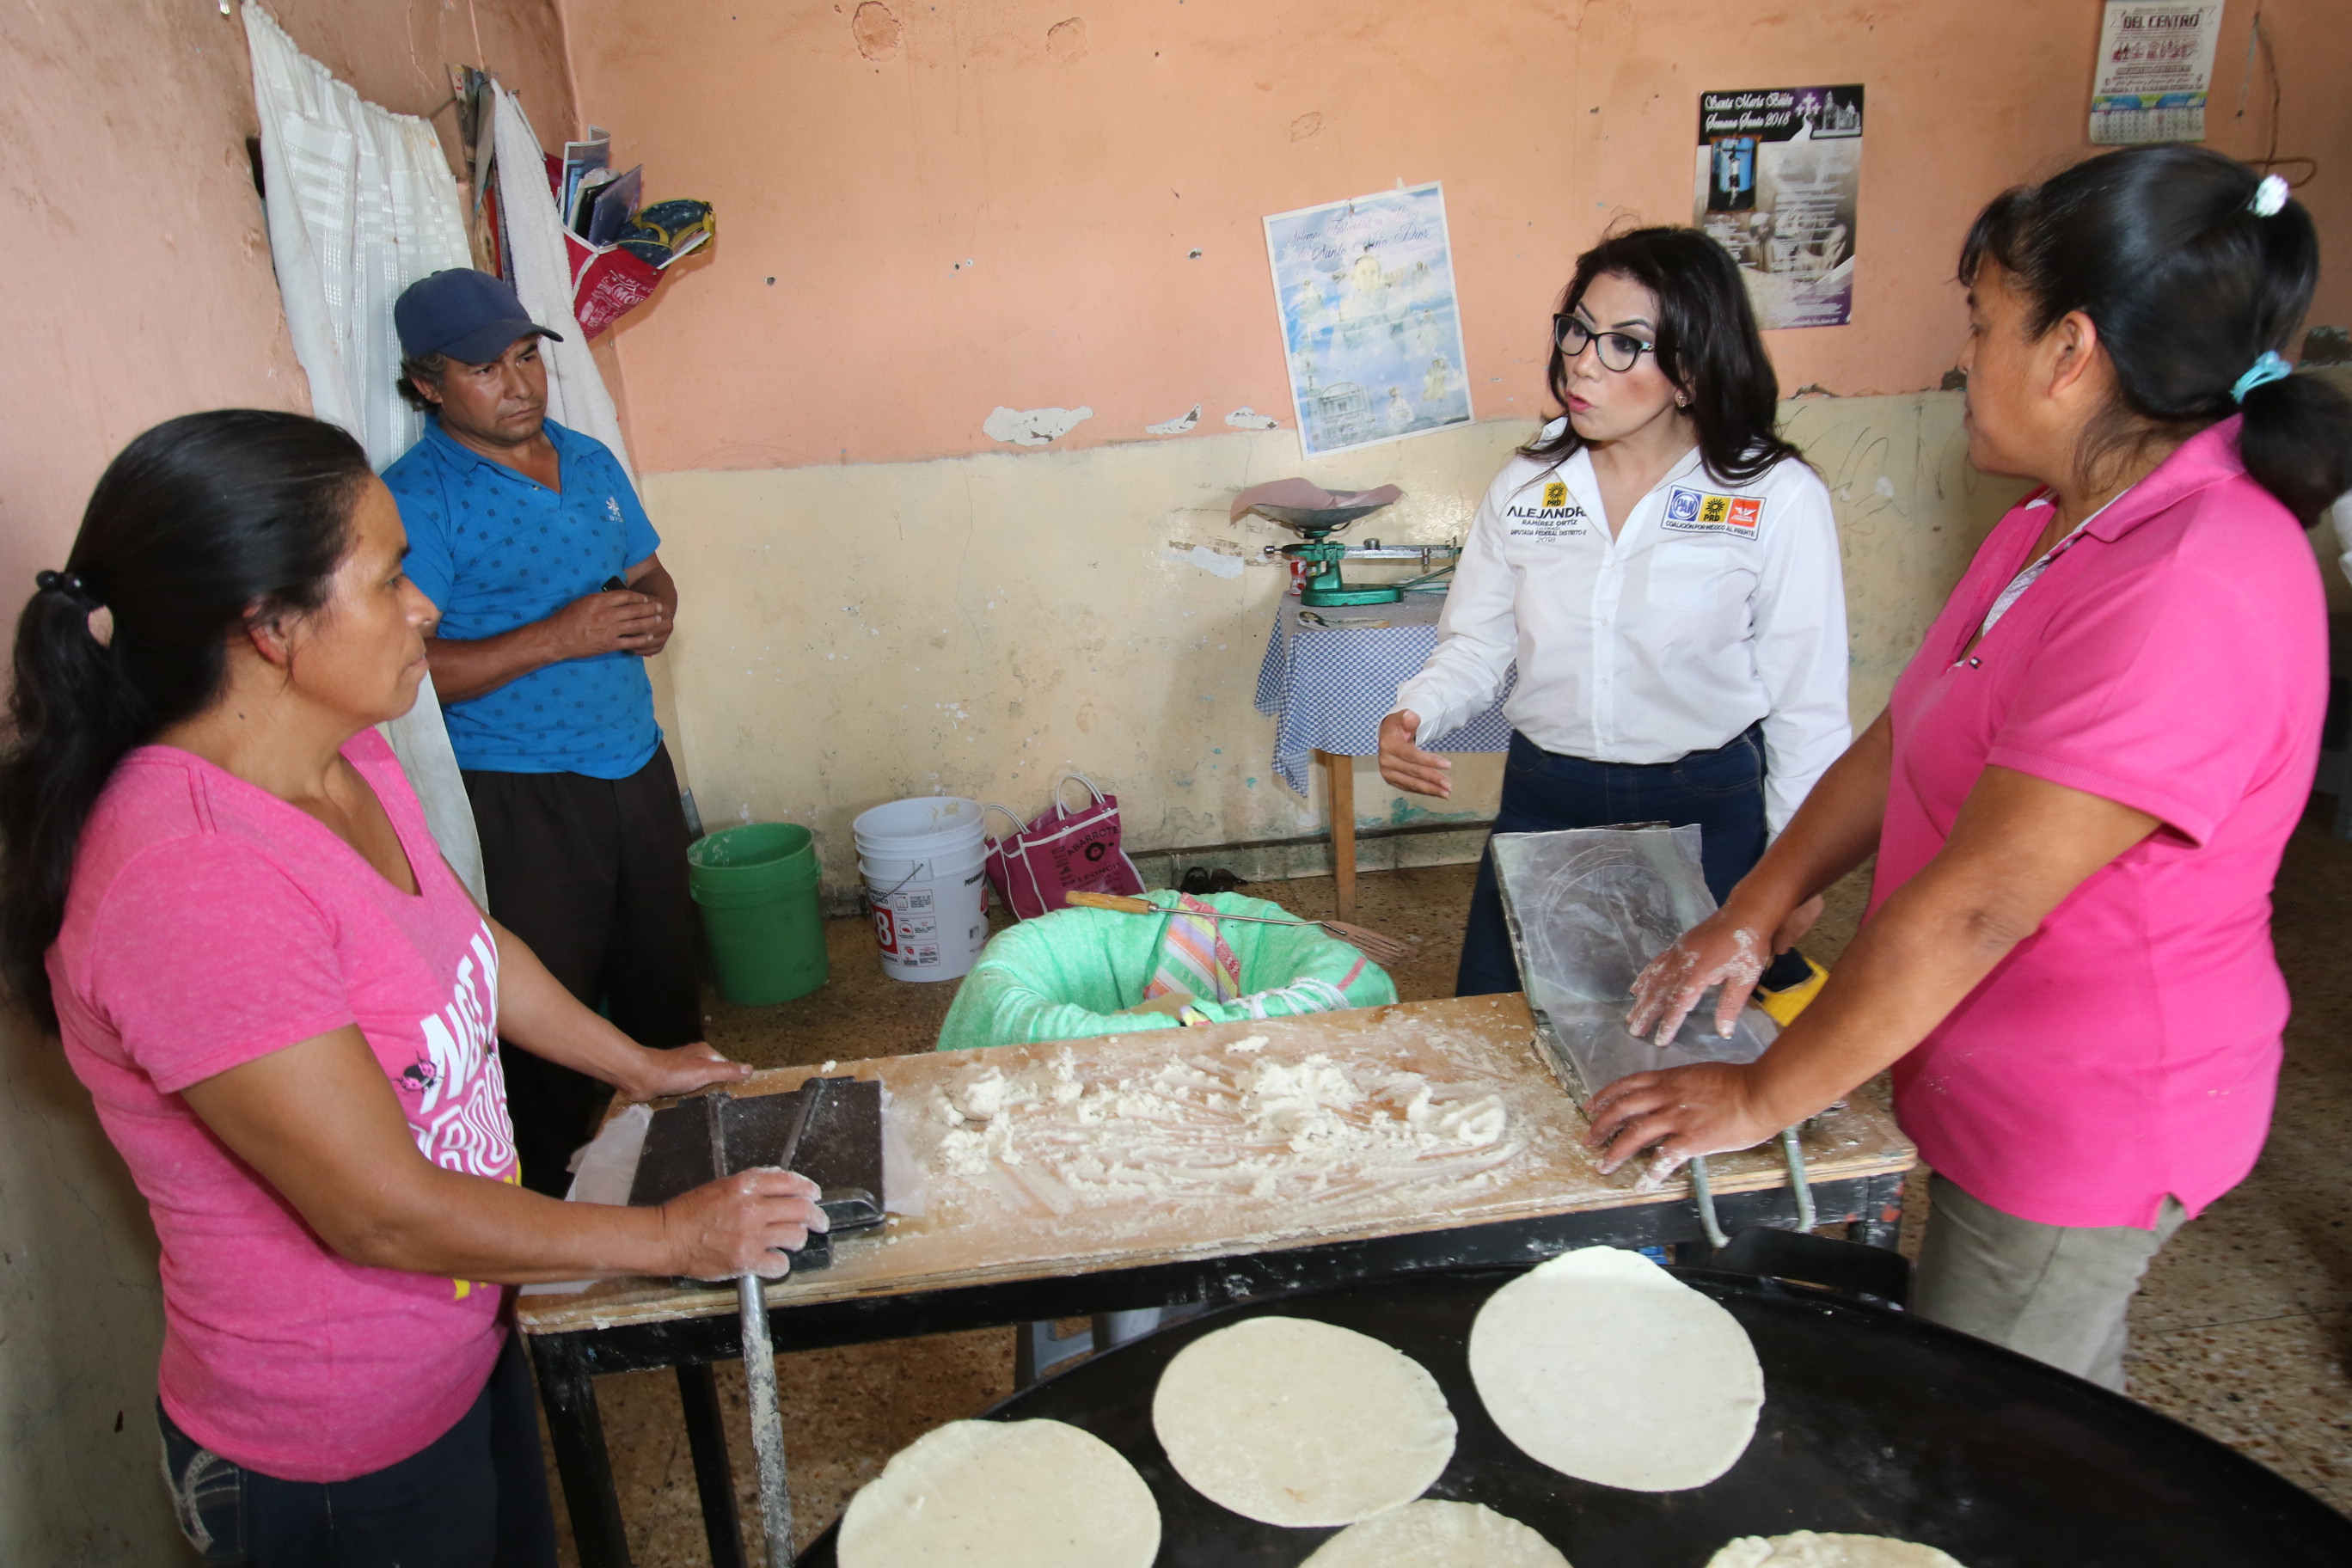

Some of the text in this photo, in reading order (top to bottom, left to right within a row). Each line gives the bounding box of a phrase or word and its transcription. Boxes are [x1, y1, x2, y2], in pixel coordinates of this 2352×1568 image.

[2122, 13, 2200, 29] DEL CENTRO
[1764, 111, 1791, 127] 2018
[1312, 242, 1346, 260] Santo
[1394, 222, 1429, 242] Dios
[1506, 505, 1587, 518] ALEJANDR
[1675, 499, 1695, 513] PAN
[1734, 528, 1755, 536] FRENTE
[1067, 826, 1119, 856] ABARROTE
